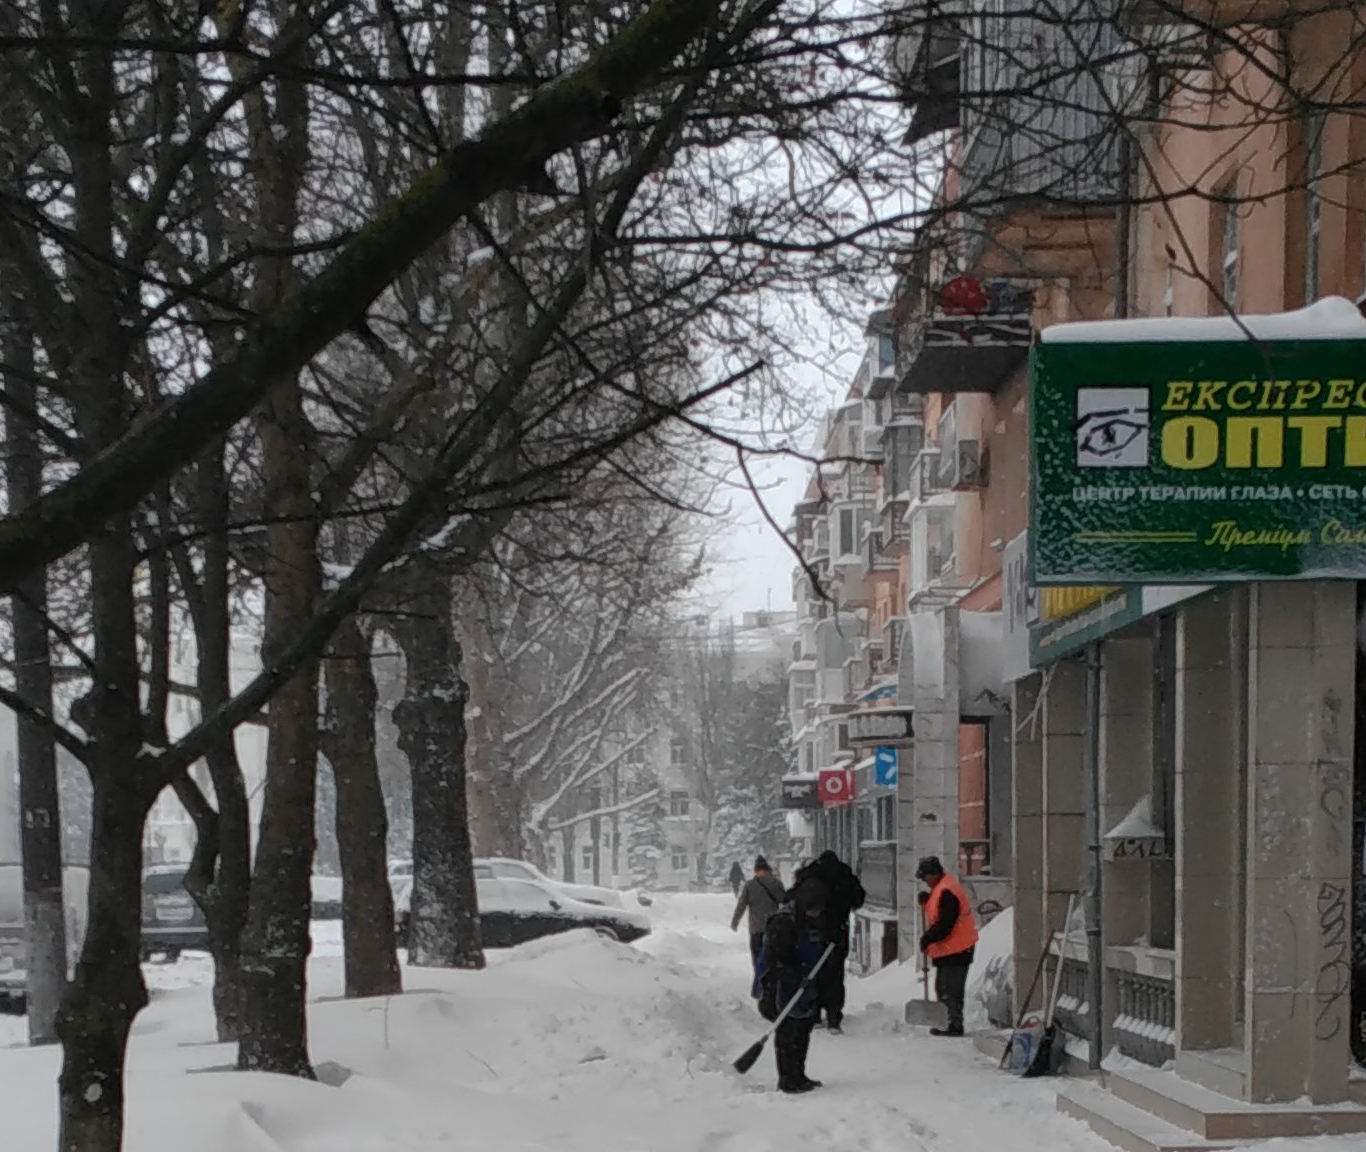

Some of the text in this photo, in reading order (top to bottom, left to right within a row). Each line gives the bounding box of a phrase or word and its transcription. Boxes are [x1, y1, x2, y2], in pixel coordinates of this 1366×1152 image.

[1072, 485, 1135, 501] ЦЕНТР
[1138, 485, 1226, 501] ТЕРАПИИ
[1230, 484, 1293, 500] ГЛАЗА
[1308, 484, 1358, 499] СЕТЬ
[1203, 519, 1313, 553] Преміум
